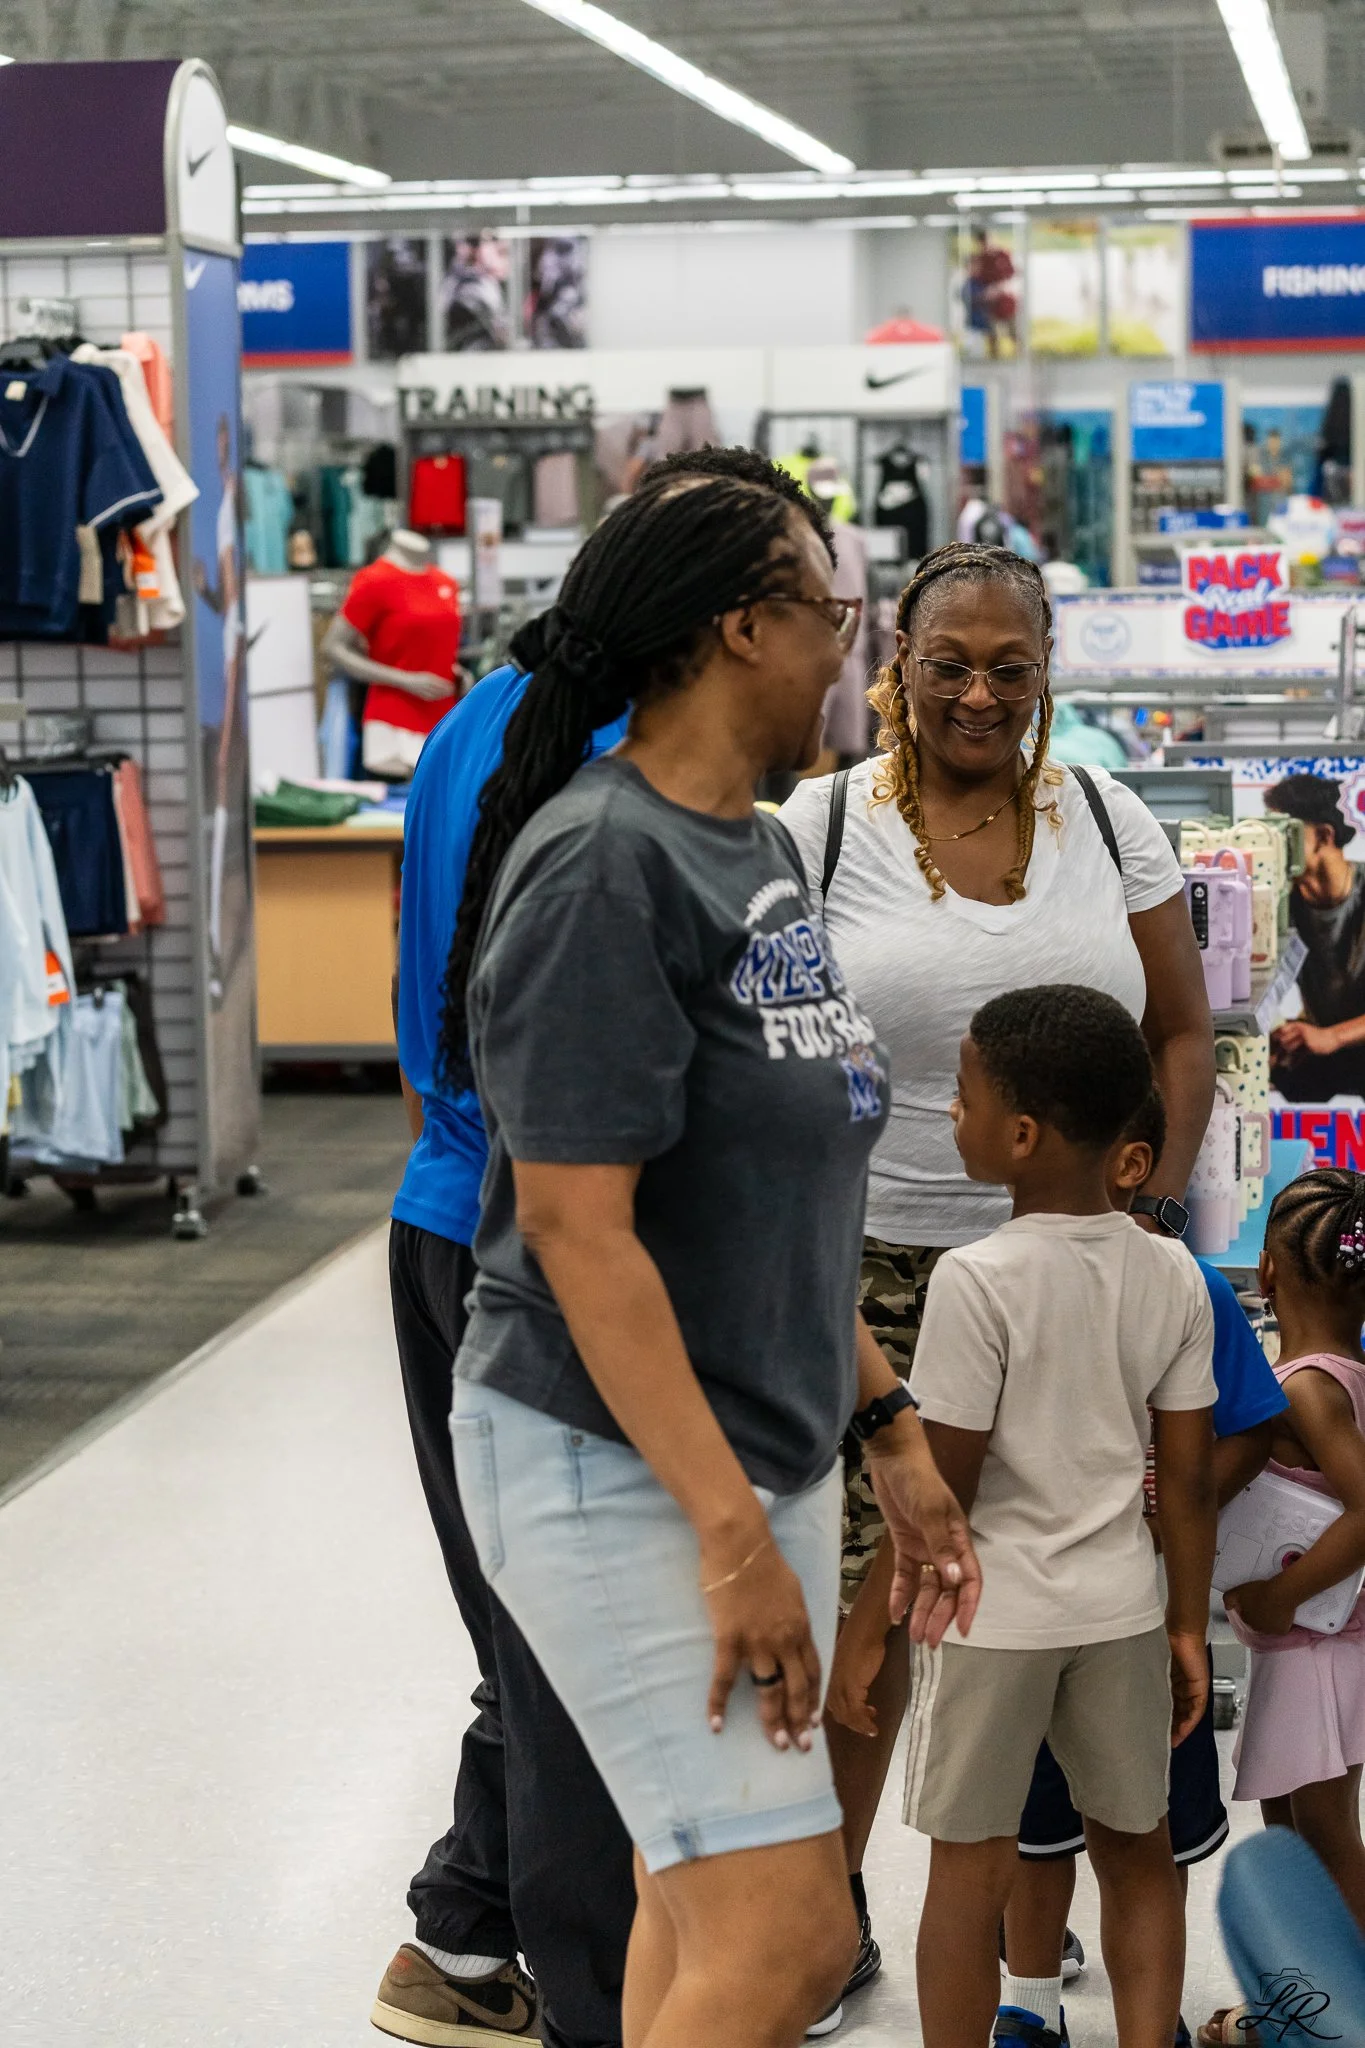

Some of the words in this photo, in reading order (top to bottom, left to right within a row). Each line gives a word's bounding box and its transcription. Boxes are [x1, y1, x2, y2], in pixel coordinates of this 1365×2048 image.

[397, 384, 594, 421] TRAINING
[1188, 552, 1283, 593] PACK
[1184, 600, 1293, 640] GAME
